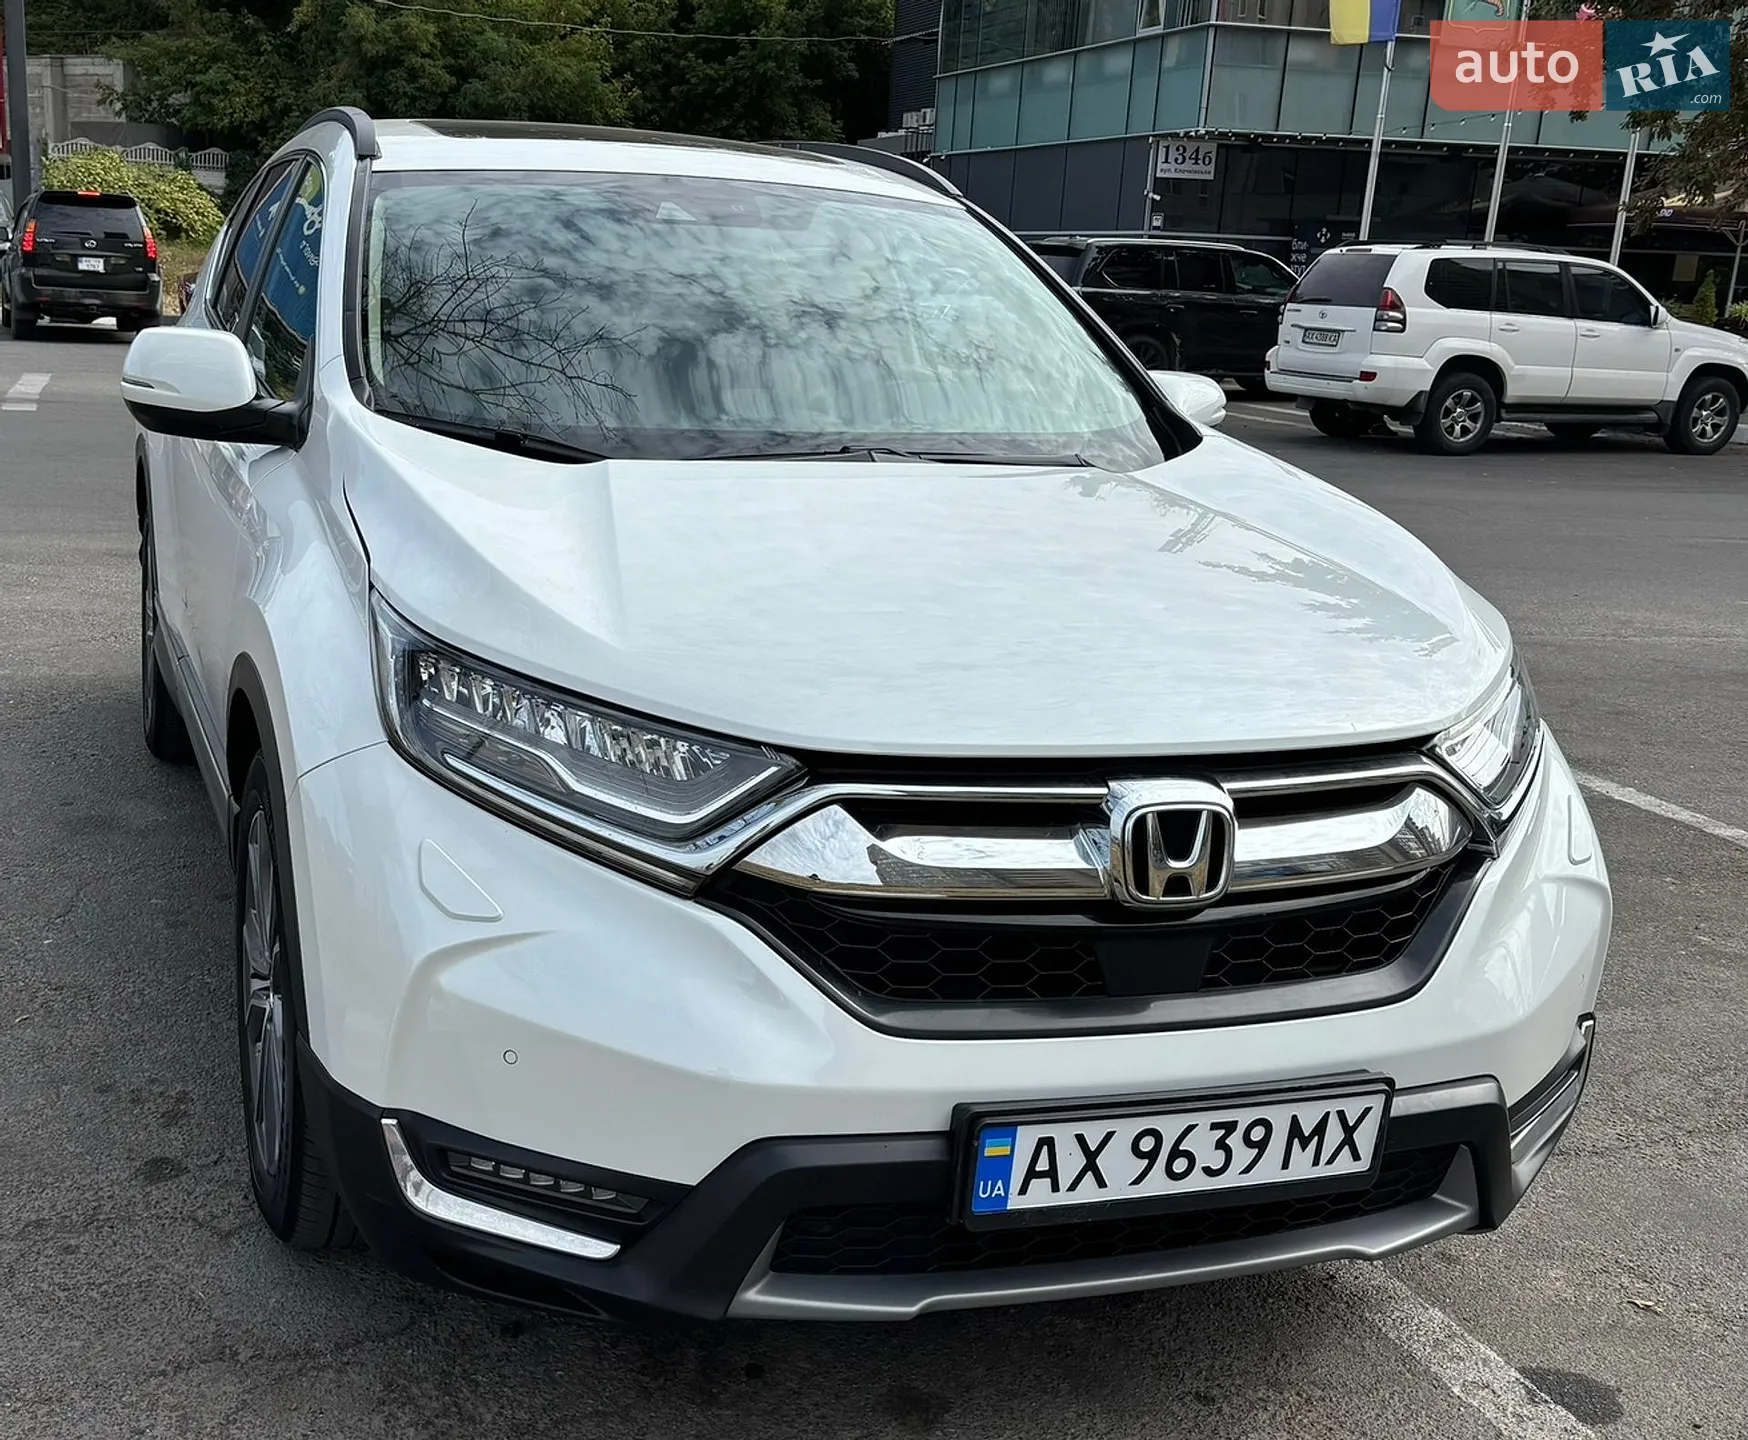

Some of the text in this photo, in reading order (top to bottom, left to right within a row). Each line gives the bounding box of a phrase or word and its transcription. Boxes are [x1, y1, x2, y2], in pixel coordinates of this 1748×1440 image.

[1016, 1105, 1375, 1197] AX 9639 MX
[978, 1179, 1005, 1199] UA
